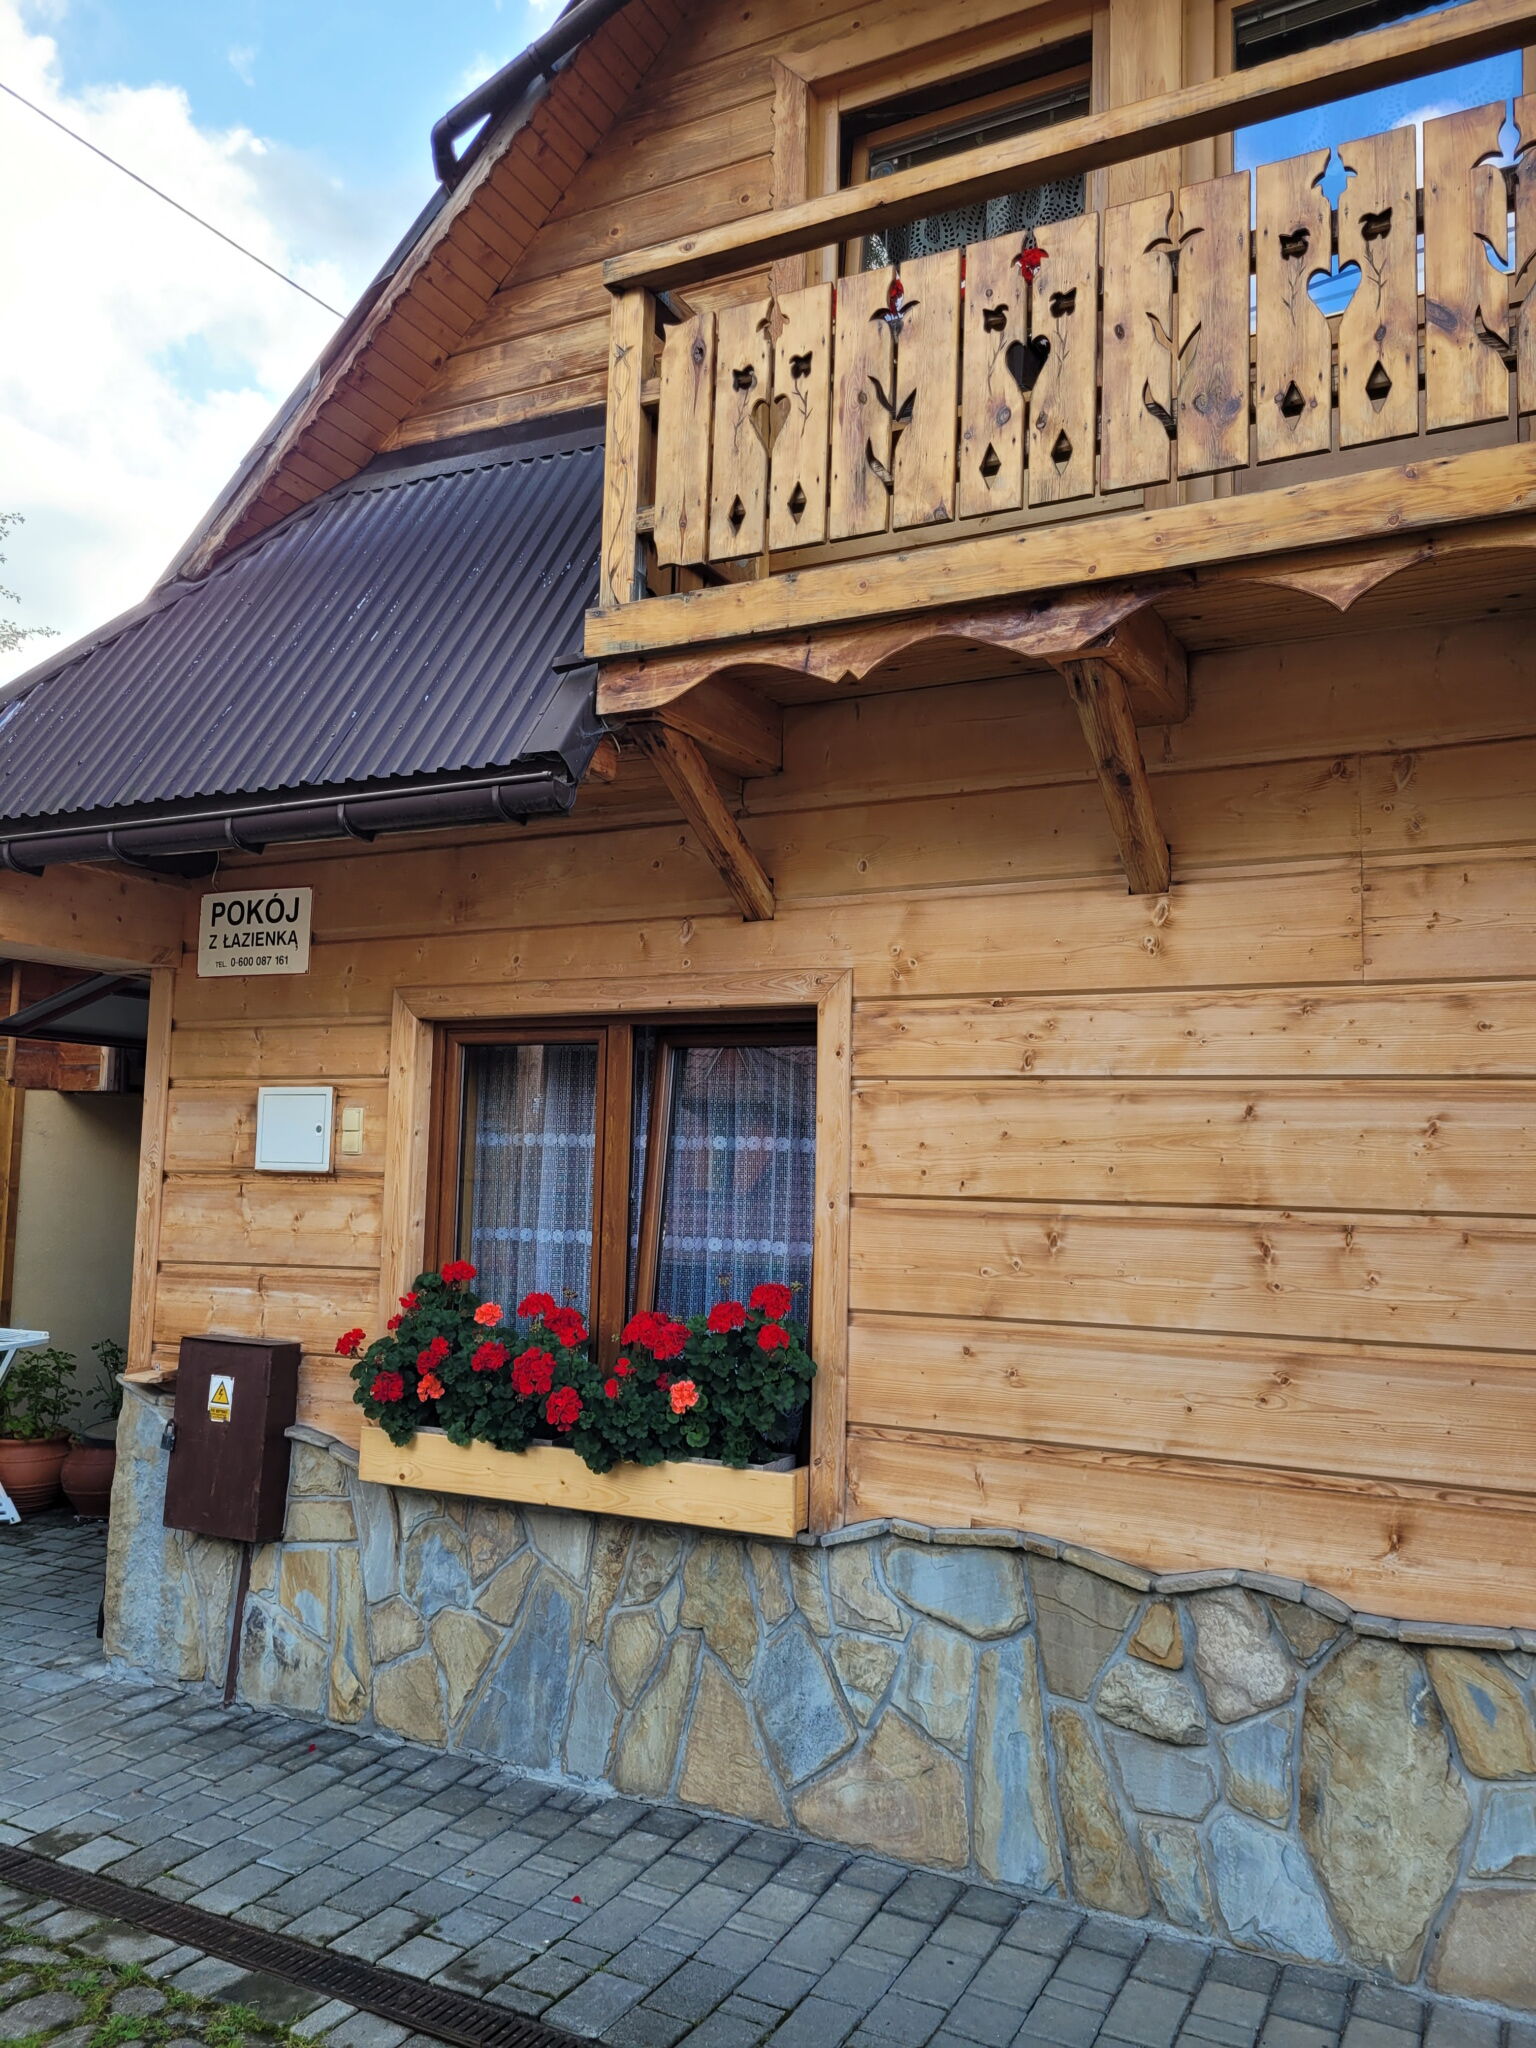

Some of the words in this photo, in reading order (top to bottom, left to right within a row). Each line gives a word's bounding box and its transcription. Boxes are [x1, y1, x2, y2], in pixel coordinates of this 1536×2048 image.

[211, 893, 299, 927] POKÓJ
[209, 935, 218, 949] Z
[223, 930, 298, 951] ŁAZIENKĄ
[230, 956, 254, 968] 0-600
[256, 955, 272, 966] 087
[275, 955, 288, 965] 161
